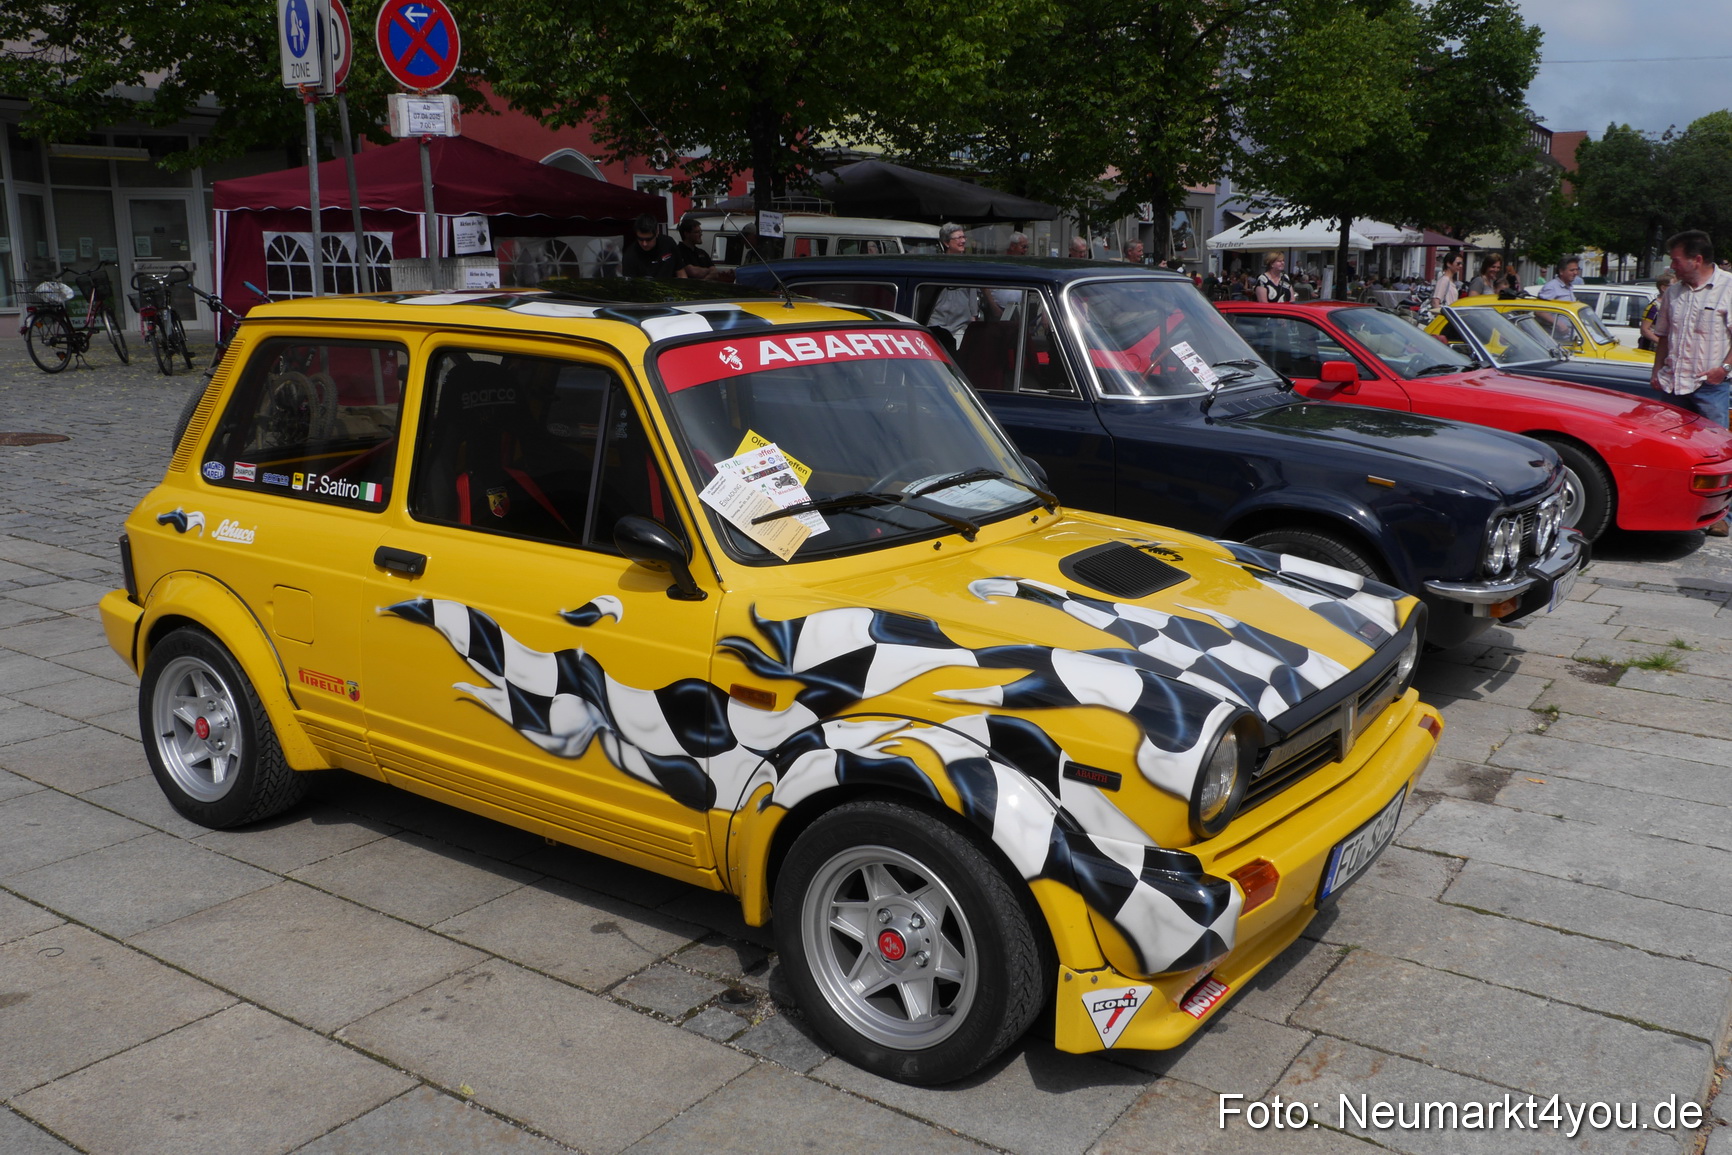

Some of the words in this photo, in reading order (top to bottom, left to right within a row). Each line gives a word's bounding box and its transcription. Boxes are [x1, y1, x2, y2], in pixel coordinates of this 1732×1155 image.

[291, 62, 311, 79] ZONE
[1215, 241, 1244, 249] Tucher
[759, 333, 918, 366] ABARTH
[461, 387, 516, 407] sparco
[235, 466, 254, 476] CHAMPION
[212, 519, 255, 543] Schuco
[298, 668, 345, 695] PIRELLI
[1075, 769, 1108, 784] ABARTH
[1334, 834, 1365, 885] FÜ
[1094, 998, 1136, 1012] KONI
[1184, 980, 1227, 1018] MOTUL
